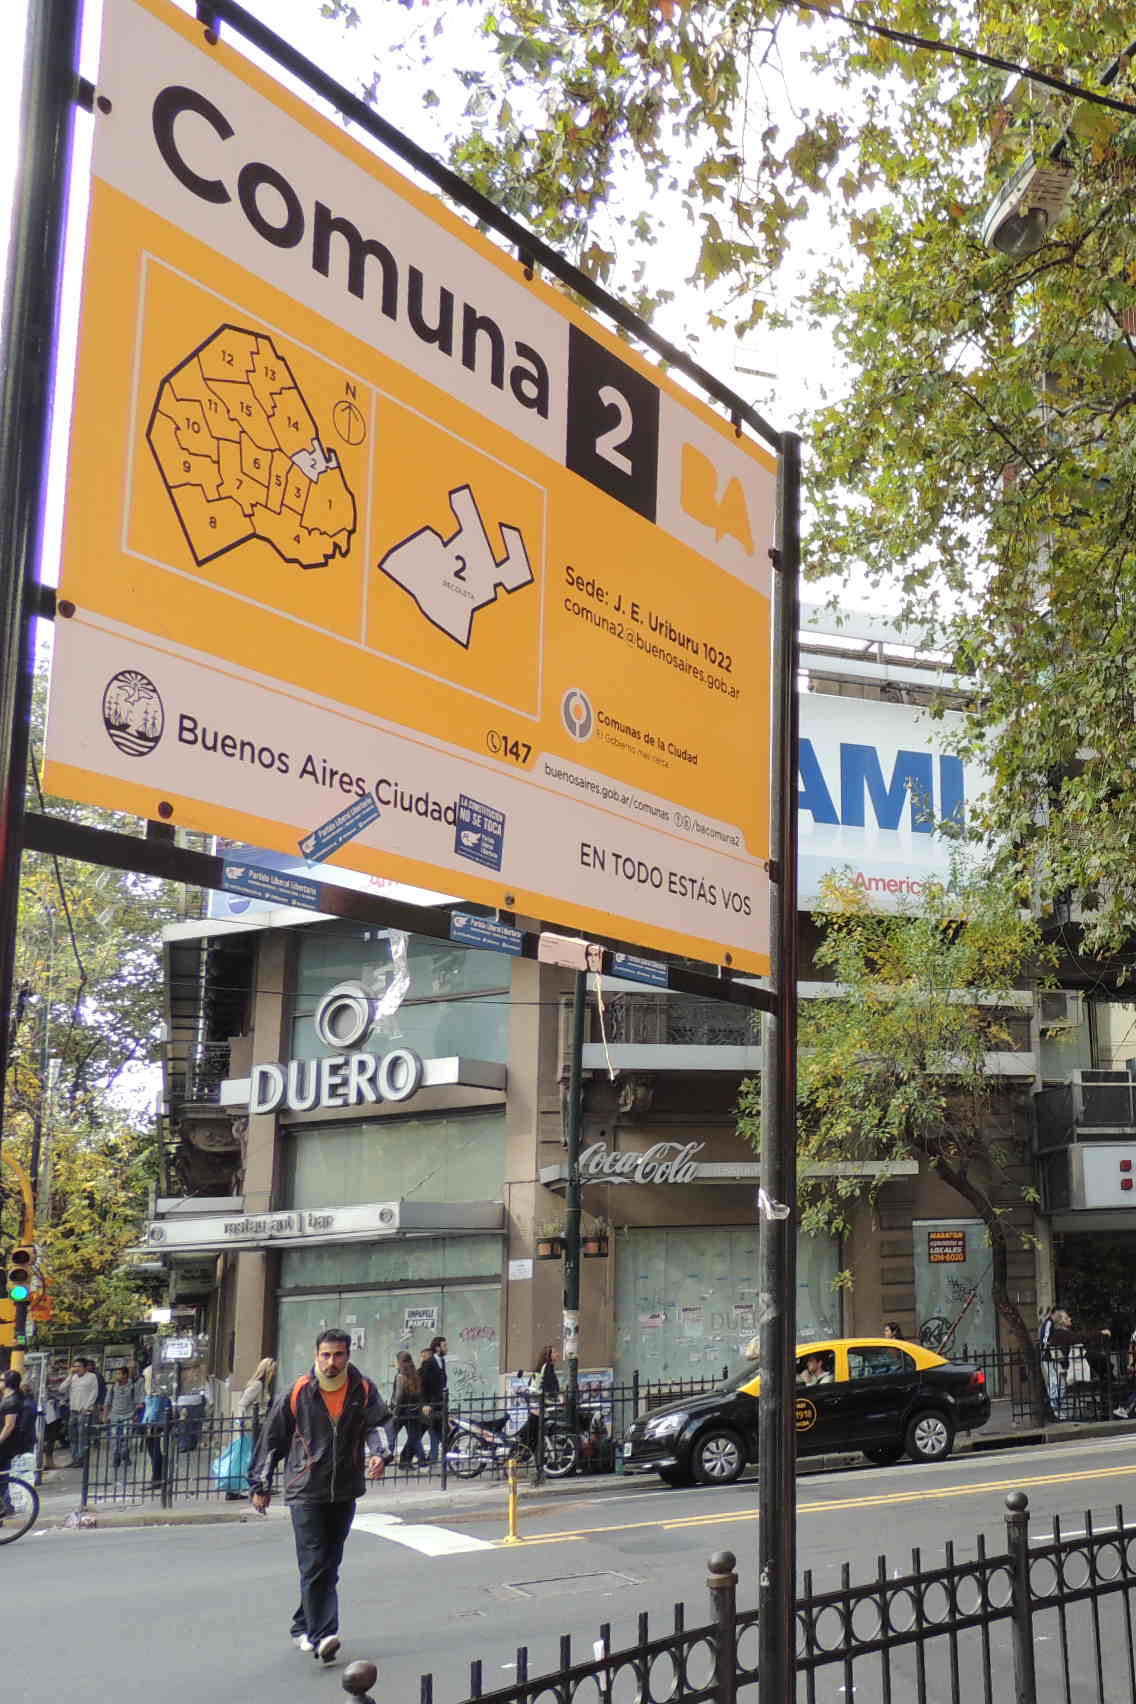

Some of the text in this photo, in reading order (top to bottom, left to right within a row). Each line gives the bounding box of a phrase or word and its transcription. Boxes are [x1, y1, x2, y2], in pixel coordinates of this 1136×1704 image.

[152, 85, 635, 478] Comuna 2
[221, 350, 235, 367] 12
[264, 366, 277, 382] 13
[345, 382, 357, 401] N
[208, 399, 219, 415] 11
[240, 401, 253, 417] 15
[186, 417, 201, 434] 10
[287, 416, 300, 432] 14
[182, 460, 192, 473] 9
[252, 458, 261, 470] 6
[310, 458, 318, 470] 2
[235, 478, 244, 491] 7
[275, 475, 282, 487] 5
[294, 487, 302, 498] 3
[327, 499, 333, 510] 1
[208, 516, 218, 529] 8
[293, 534, 301, 545] 4
[453, 554, 467, 582] 2
[565, 565, 733, 673] Sede: J. E. Uriburu 1022
[563, 596, 740, 700] comuna2@buenosaires.gob.ar
[596, 710, 698, 765] Comunas de la Ciudad
[501, 735, 533, 764] 147
[177, 713, 458, 827] Buenos Aires Ciudad
[544, 762, 670, 821] buenosaires.gob.ar/comunas
[472, 812, 482, 828] SE
[483, 817, 502, 836] TOCA
[249, 870, 269, 882] Partido
[580, 842, 752, 917] EN TODO ESTÁS VOS
[852, 871, 945, 897] Americ
[248, 1049, 424, 1114] DUERO
